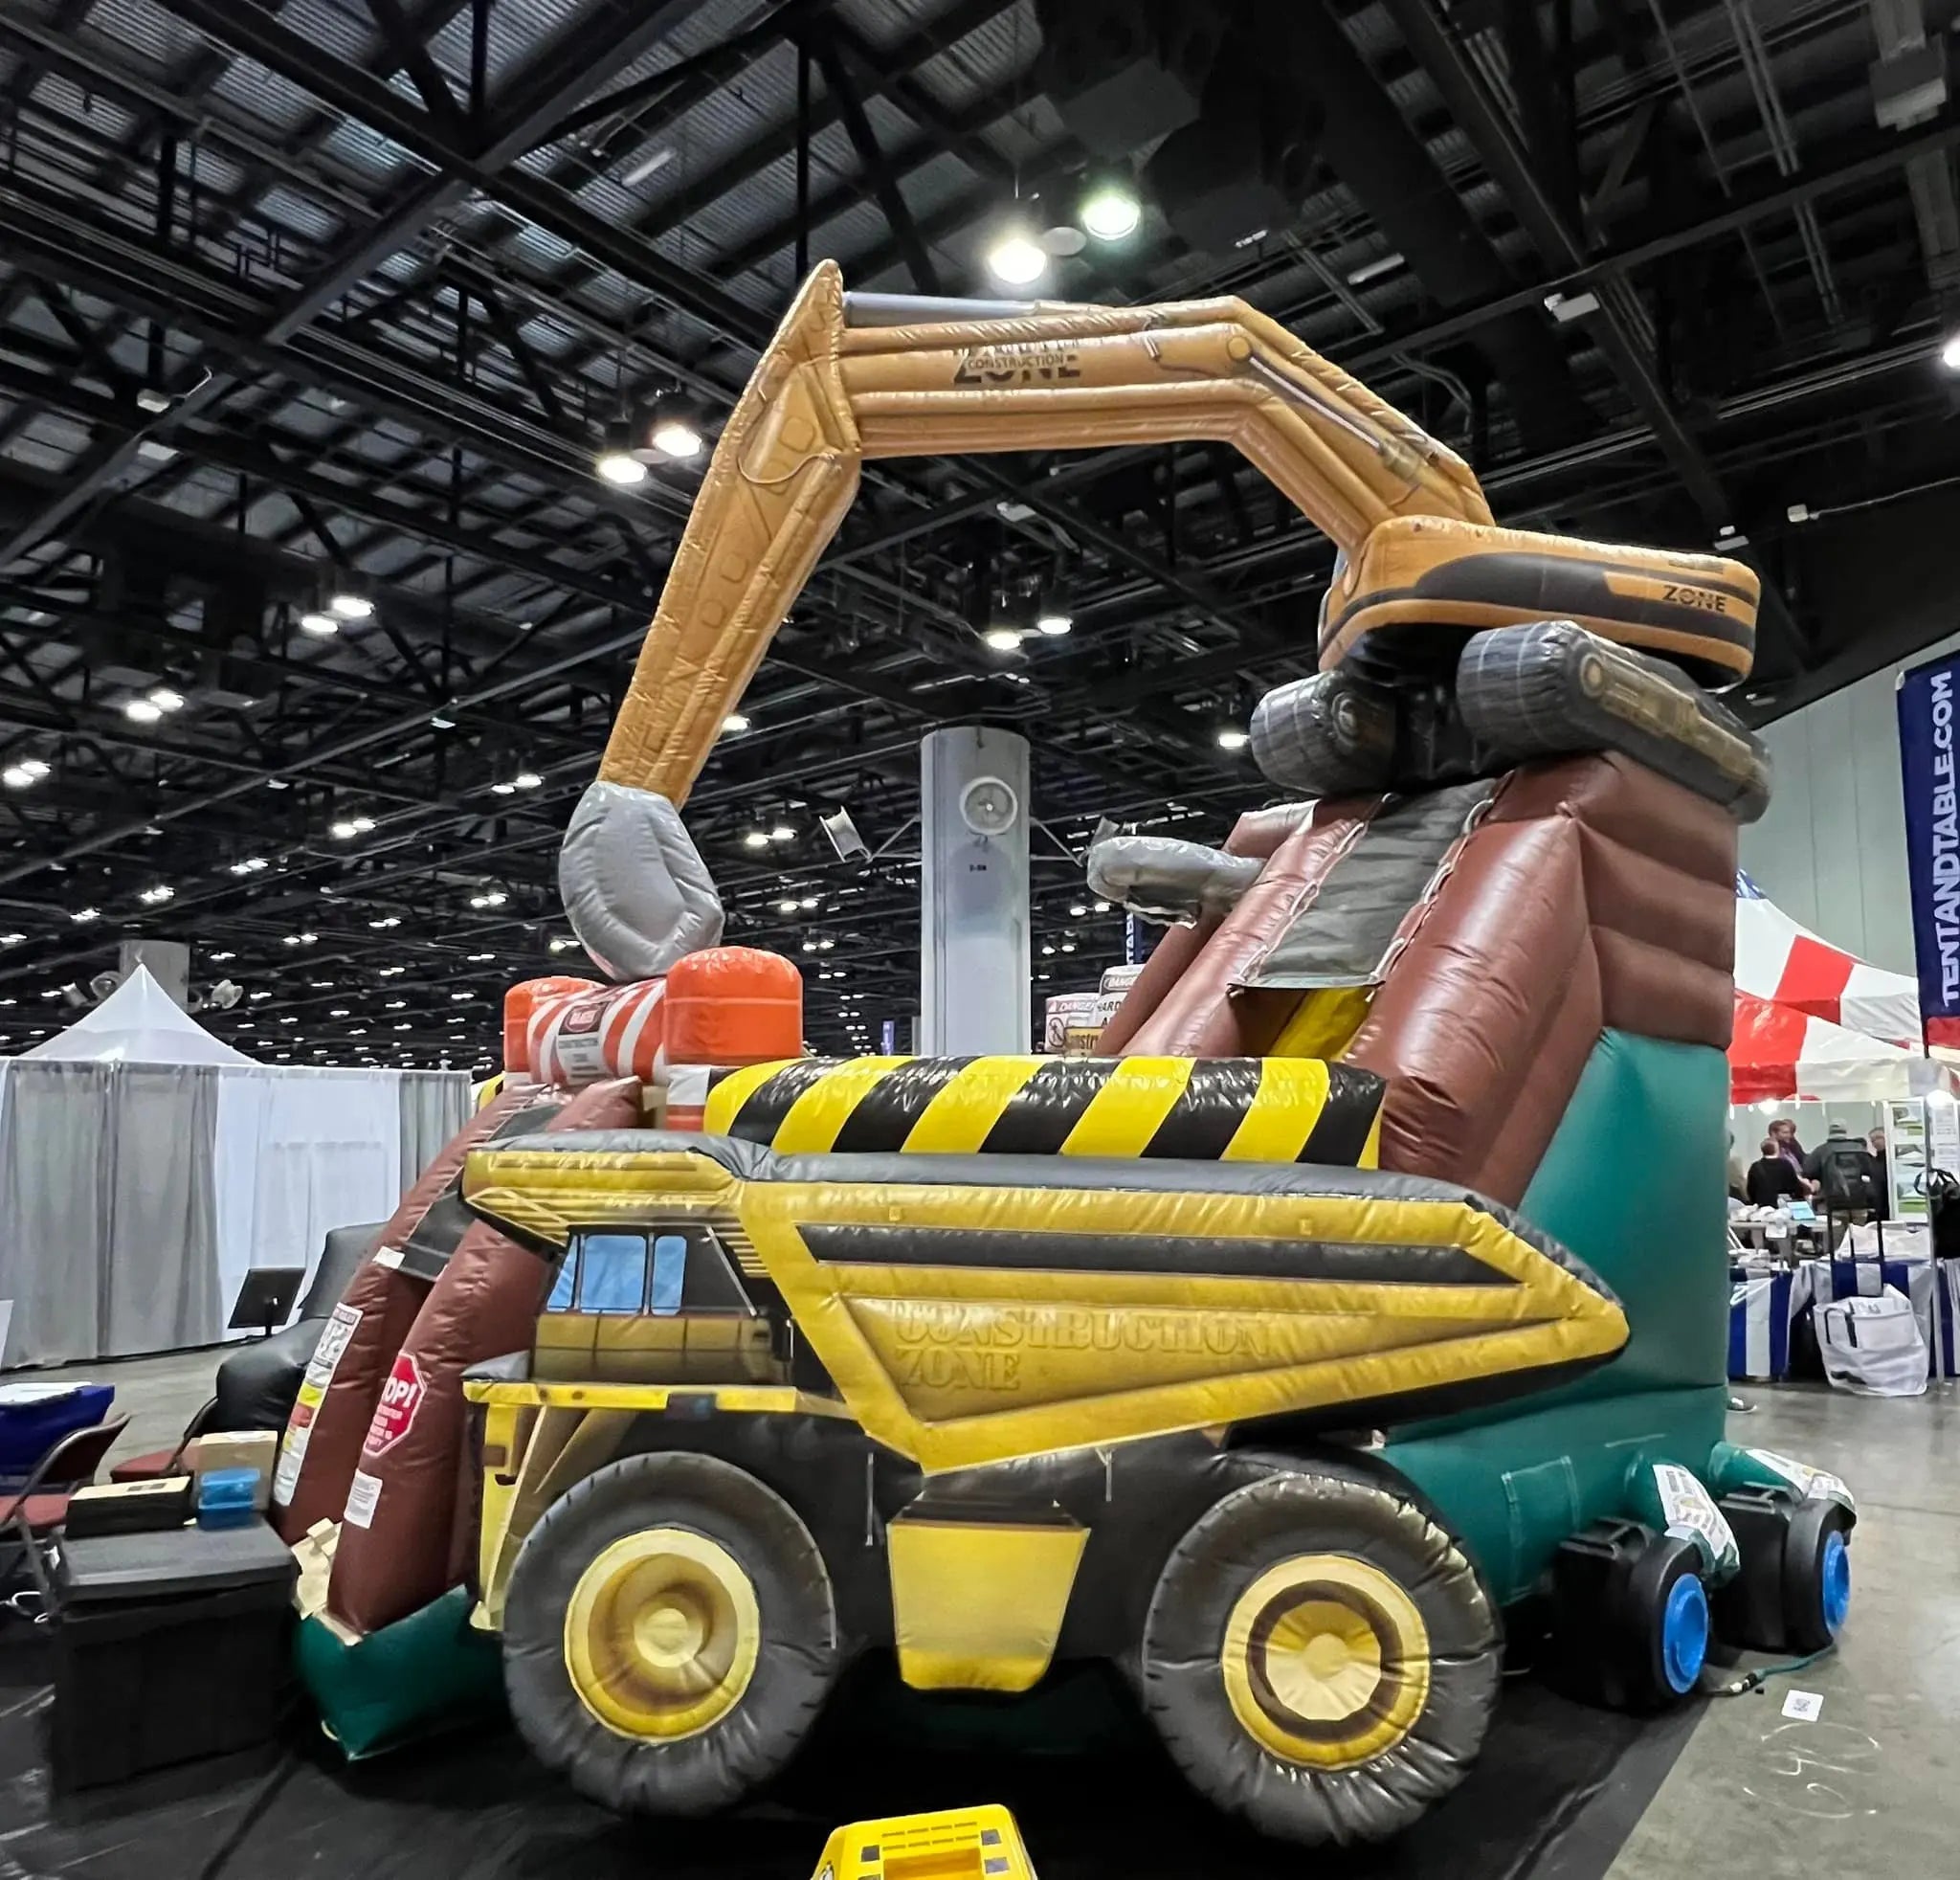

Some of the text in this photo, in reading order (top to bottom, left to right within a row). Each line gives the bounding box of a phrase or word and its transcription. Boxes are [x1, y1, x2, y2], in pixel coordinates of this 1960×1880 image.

[968, 353, 1064, 370] CONSTRUCTION
[1662, 584, 1728, 613] ZONE
[1930, 670, 1960, 1008] TENTANDTABLE.COM
[896, 1301, 1271, 1356] CONSTRUCTION
[896, 1345, 1021, 1391] ZONE
[382, 1376, 418, 1408] OP!
